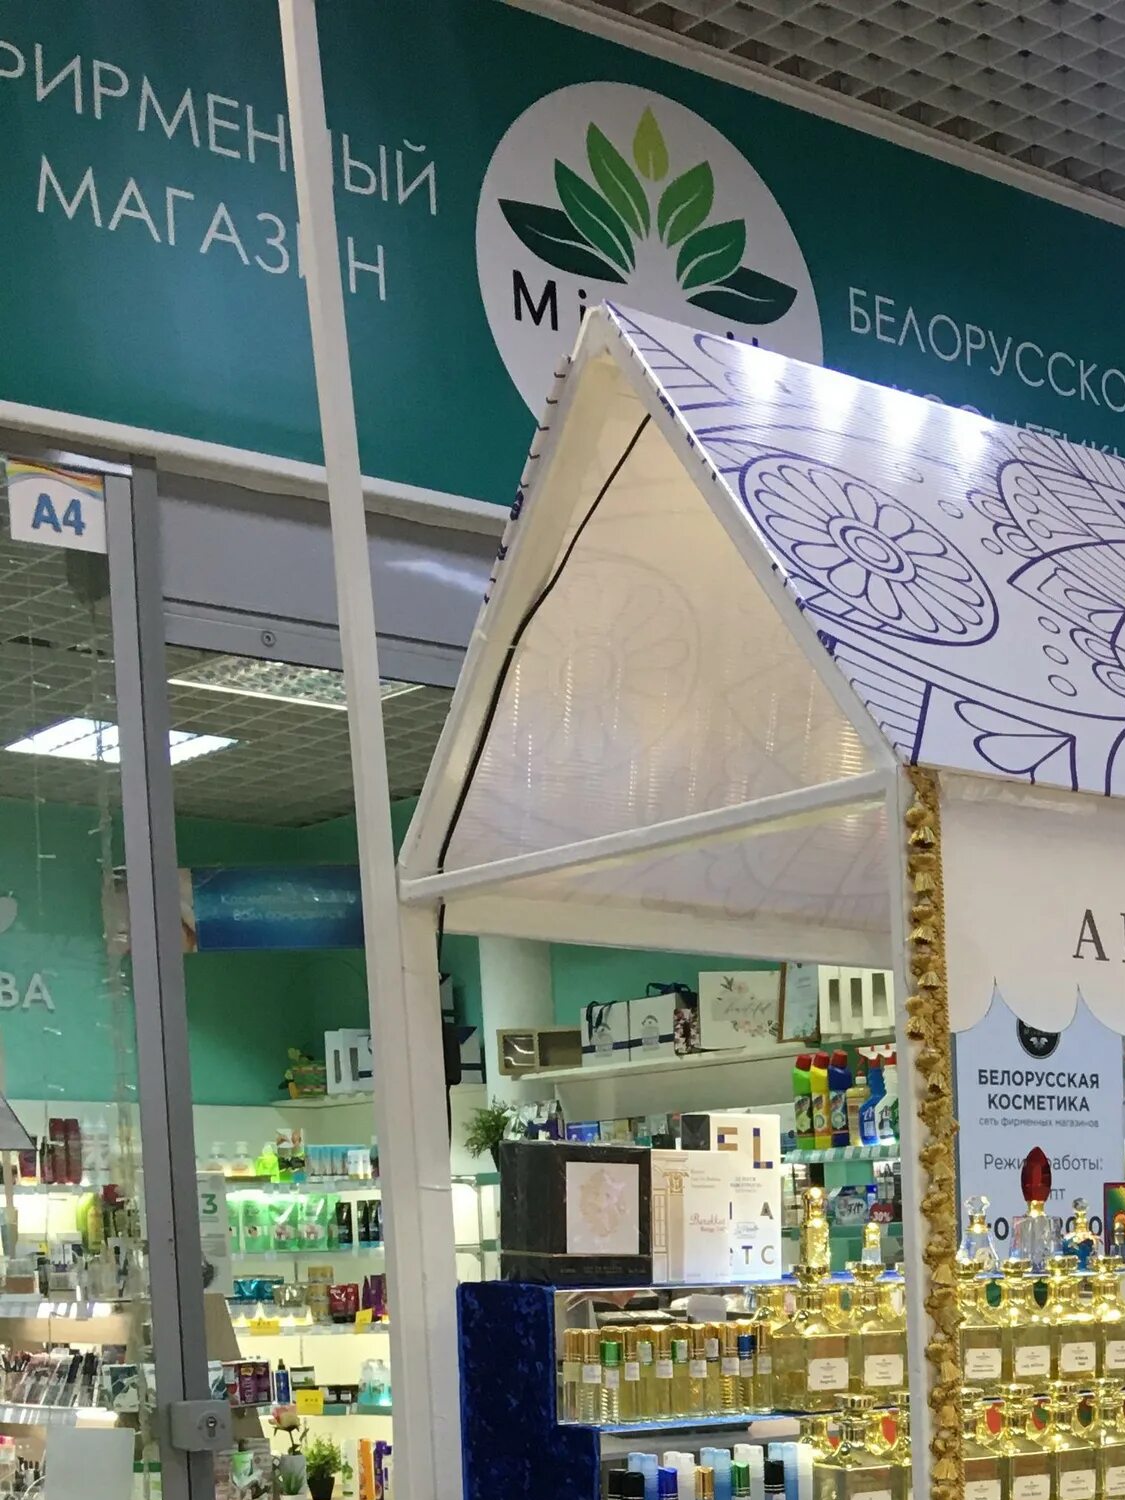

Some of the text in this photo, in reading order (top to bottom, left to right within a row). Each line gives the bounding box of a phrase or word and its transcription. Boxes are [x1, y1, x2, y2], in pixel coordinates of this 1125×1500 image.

[0, 38, 437, 217] ИРМЕНЫЙ
[36, 152, 387, 301] МАГАЗН
[978, 1069, 1100, 1089] БЕЛОРУССКАЯ
[987, 1093, 1090, 1112] КОСМЕТИКА
[983, 1153, 1103, 1171] Режи аботы:
